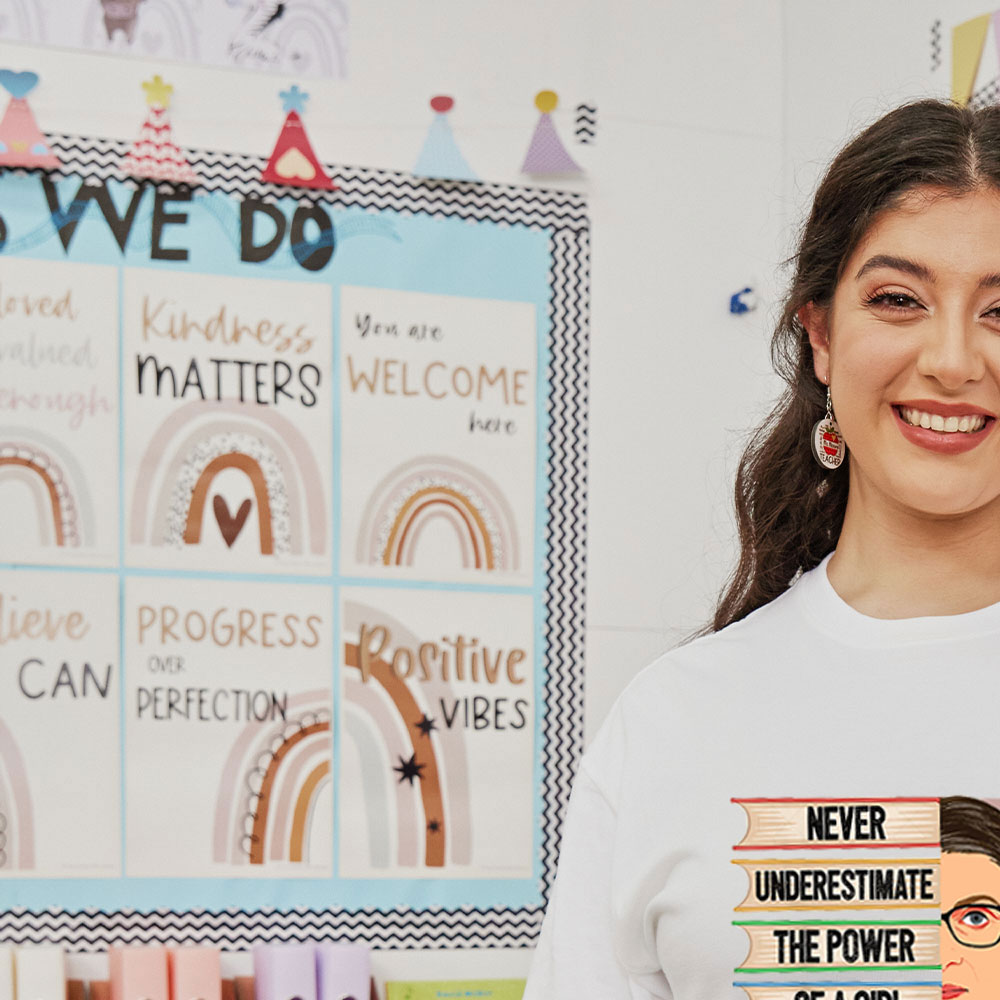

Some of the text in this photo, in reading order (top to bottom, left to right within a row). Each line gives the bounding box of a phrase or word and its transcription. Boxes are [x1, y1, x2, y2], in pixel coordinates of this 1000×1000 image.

[40, 176, 194, 261] WE
[240, 196, 336, 271] DO
[141, 295, 316, 353] Kindness
[355, 312, 443, 341] You are
[346, 354, 530, 405] WELCOME
[469, 410, 519, 435] here
[137, 605, 322, 648] PROGRESS
[148, 654, 186, 674] OVER
[360, 624, 527, 685] Positive
[18, 657, 112, 699] CAN
[137, 687, 288, 722] PERFECTION
[438, 696, 528, 730] VIBES
[807, 805, 886, 841] NEVER
[755, 868, 934, 902] UNDERESTIMATE
[773, 928, 915, 964] THE POWER
